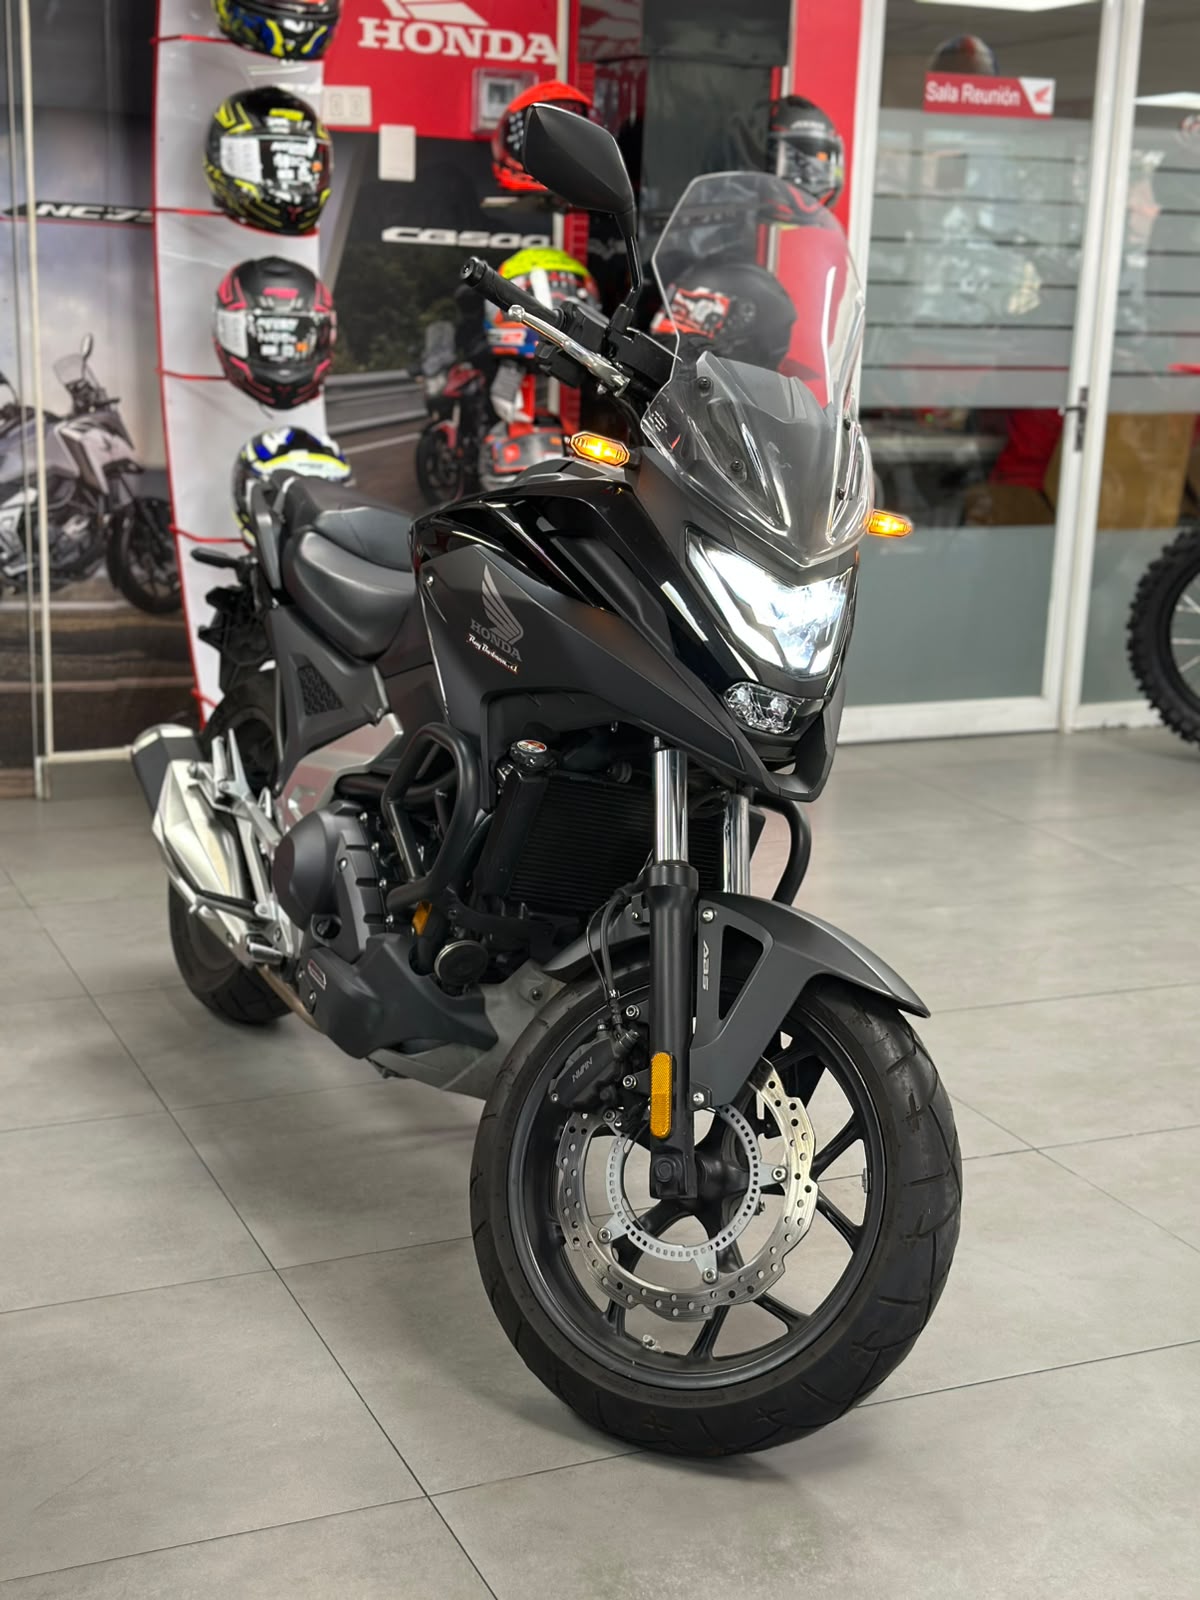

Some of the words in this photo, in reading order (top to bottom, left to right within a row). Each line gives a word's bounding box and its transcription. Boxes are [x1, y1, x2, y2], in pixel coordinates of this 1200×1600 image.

[357, 16, 559, 65] HONDA
[925, 80, 959, 104] Sala
[469, 618, 522, 662] HONDA
